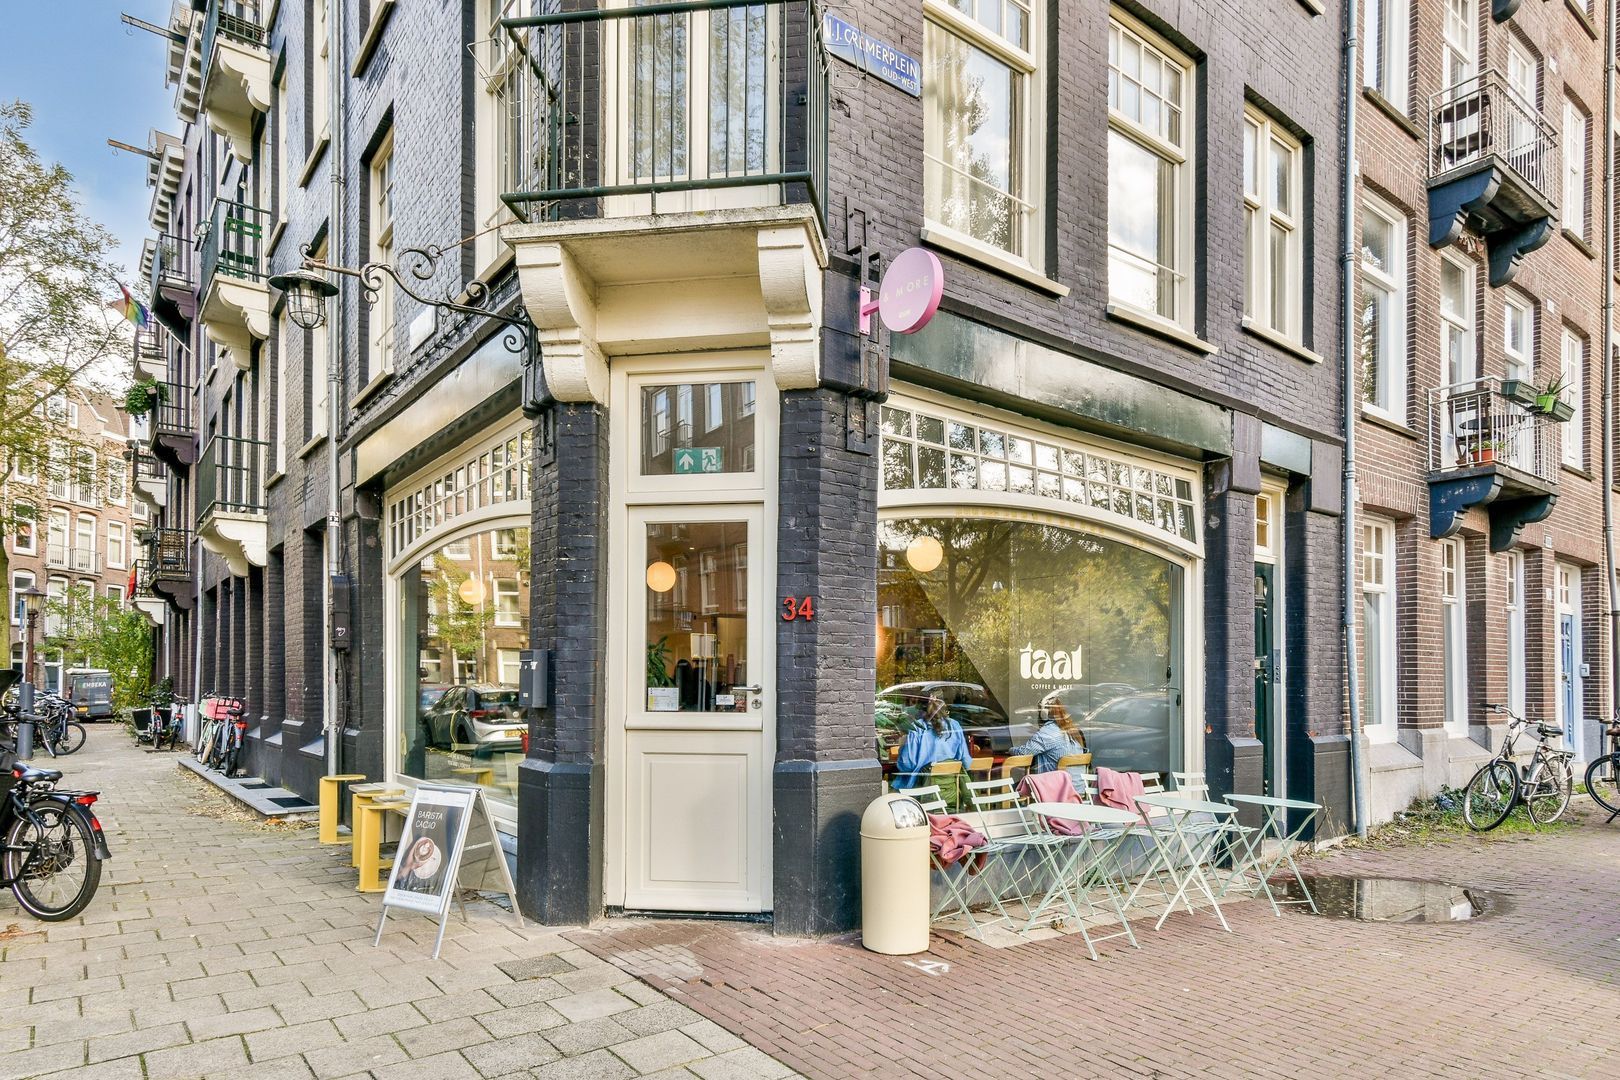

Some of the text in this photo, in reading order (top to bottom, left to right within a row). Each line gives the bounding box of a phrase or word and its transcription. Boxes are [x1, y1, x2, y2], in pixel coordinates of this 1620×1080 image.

[881, 66, 917, 91] OUD-WEST
[895, 275, 929, 297] MORE
[782, 595, 815, 621] 34
[1019, 641, 1083, 680] taal
